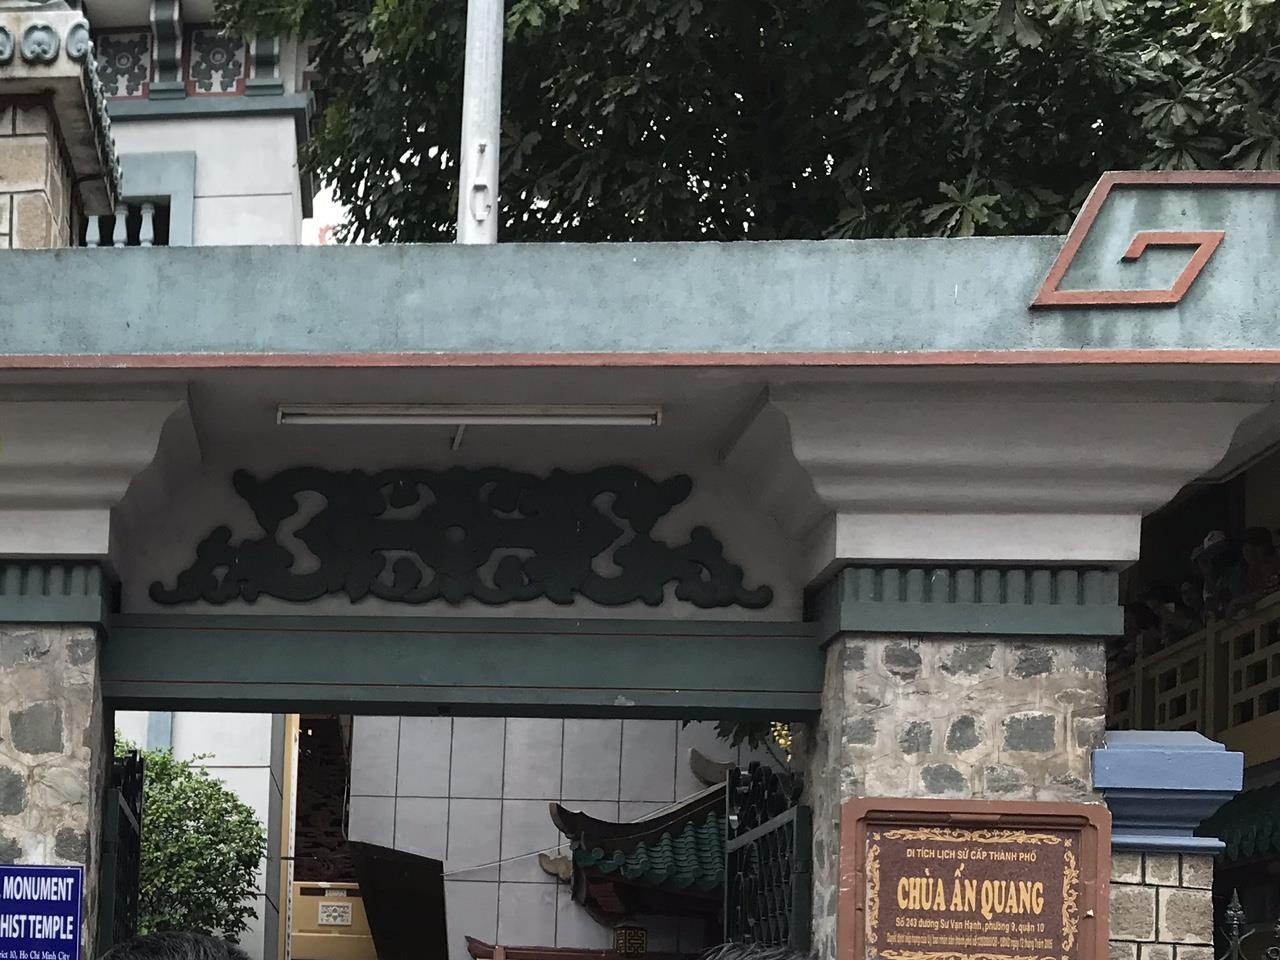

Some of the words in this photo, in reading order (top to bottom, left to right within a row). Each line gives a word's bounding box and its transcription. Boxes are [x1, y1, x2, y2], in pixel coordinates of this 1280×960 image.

[906, 848, 915, 858] DI
[916, 846, 935, 859] TÍCH
[936, 848, 955, 860] LỊCH
[970, 847, 987, 860] CẤP
[988, 848, 1017, 861] THÀNH
[1019, 849, 1037, 862] PHỐ
[3, 876, 74, 901] MONUMENT
[896, 867, 945, 911] CHÙA
[949, 862, 978, 912] ẤN
[980, 879, 1045, 920] QUANG
[27, 915, 74, 940] TEMPLE
[905, 917, 917, 928] 243
[1036, 922, 1045, 933] 10
[19, 950, 28, 960] Ho
[29, 950, 40, 960] Chi
[41, 951, 57, 960] Minh
